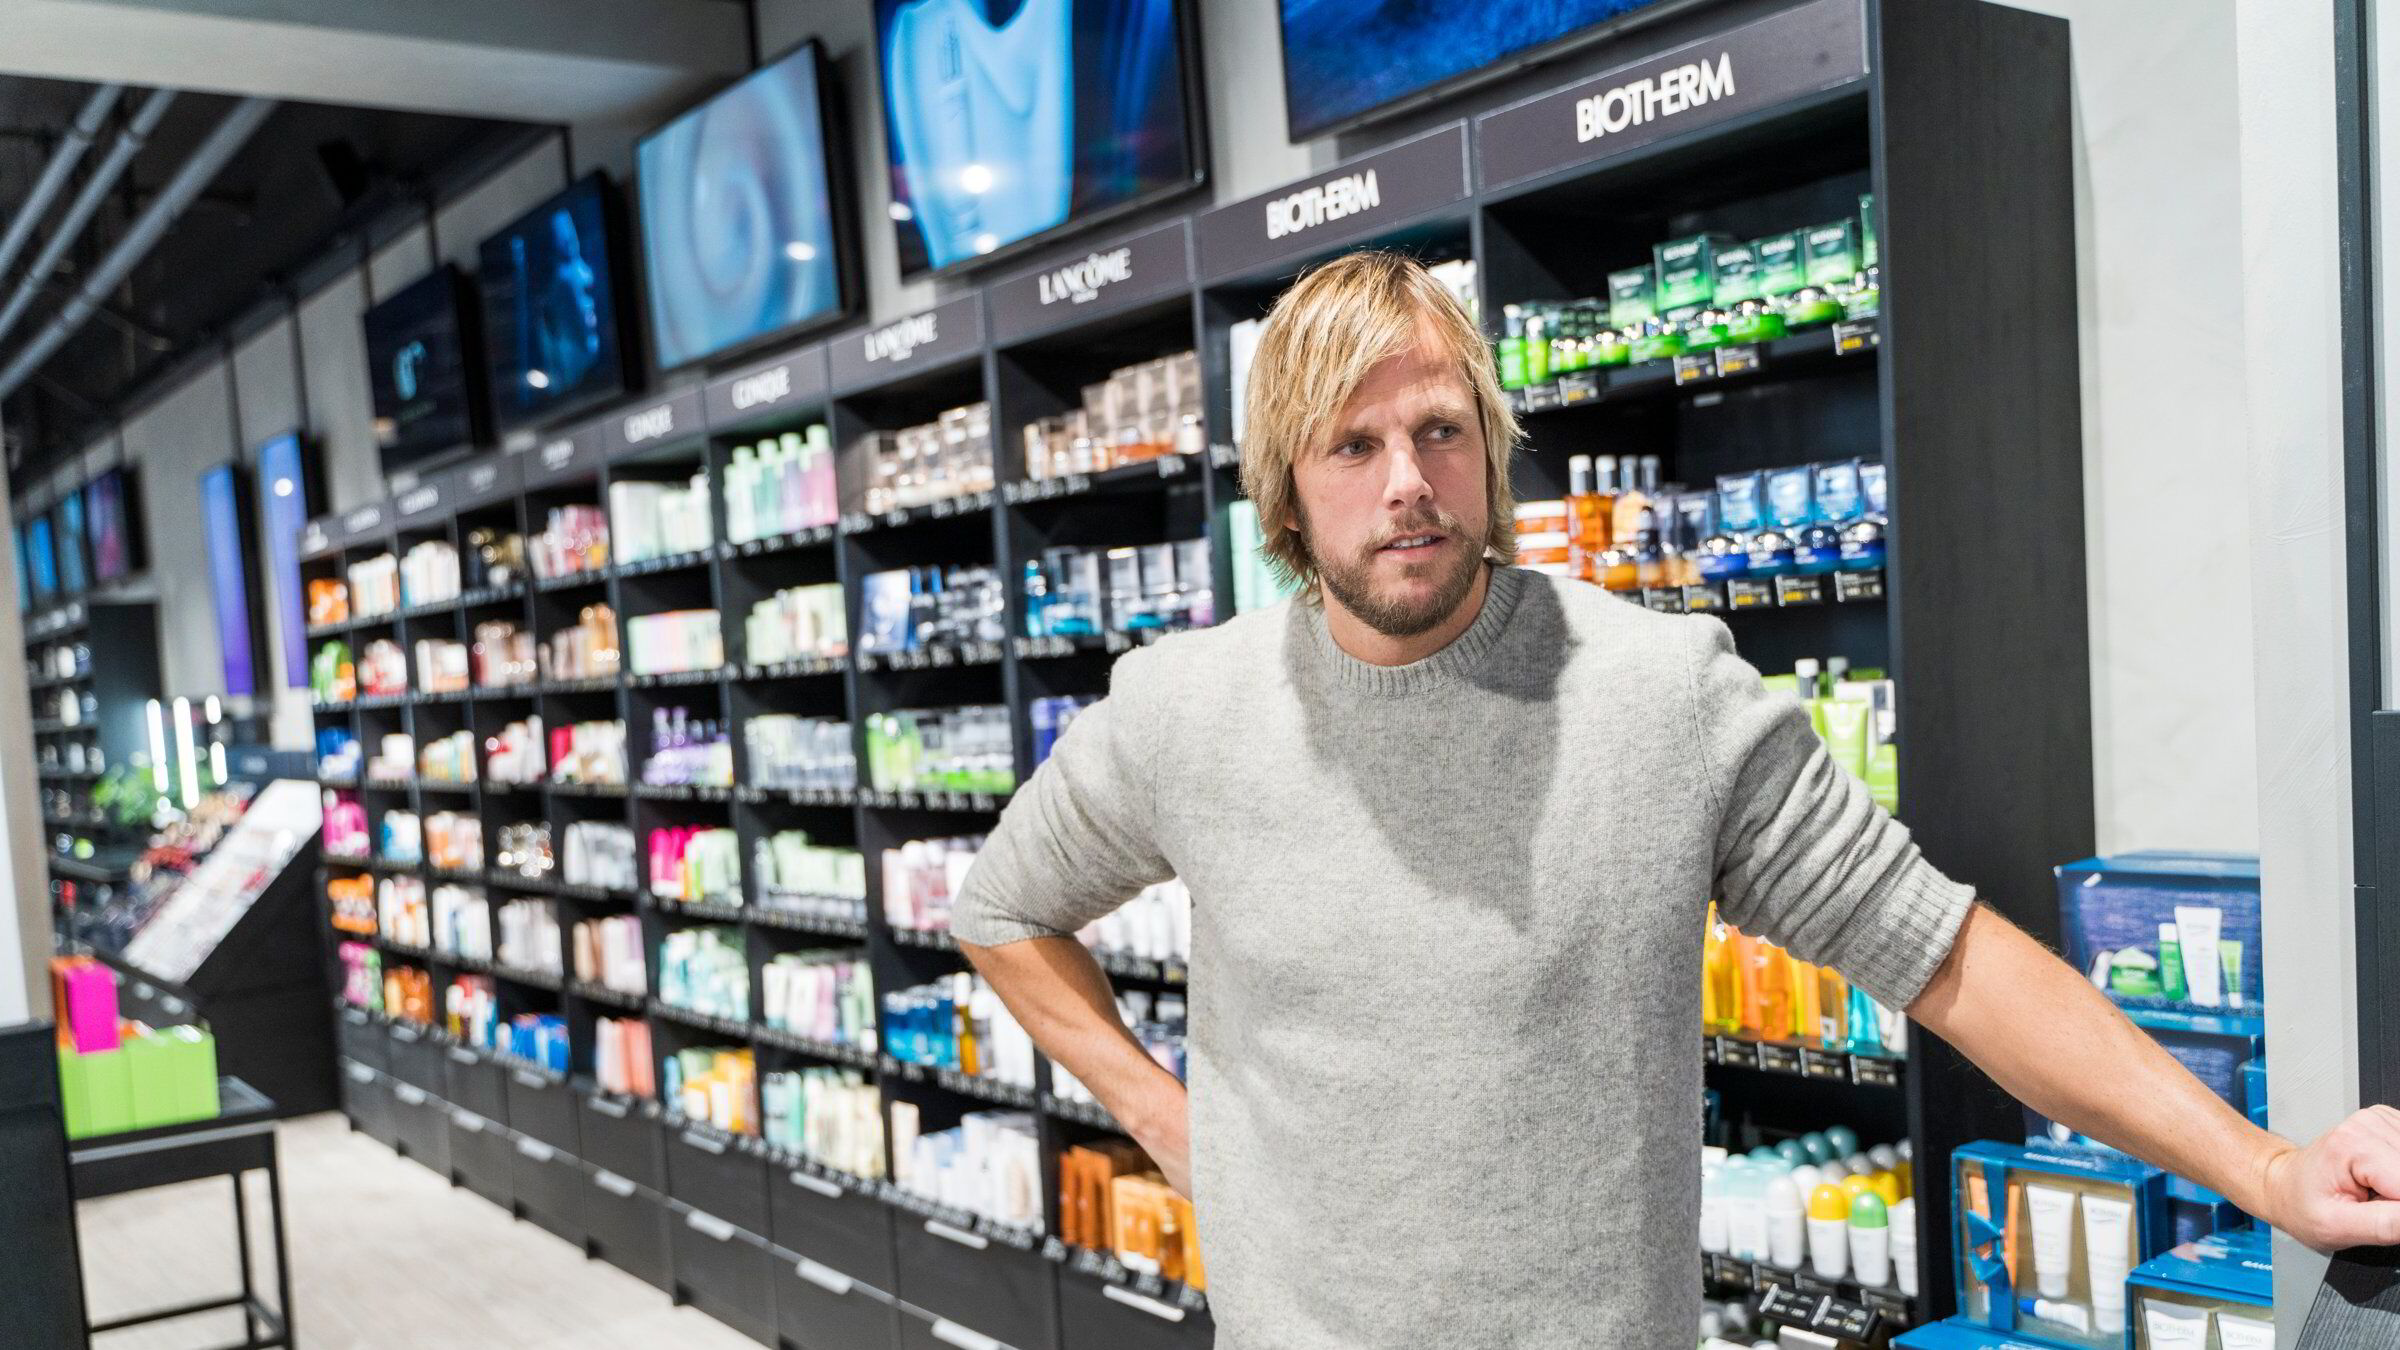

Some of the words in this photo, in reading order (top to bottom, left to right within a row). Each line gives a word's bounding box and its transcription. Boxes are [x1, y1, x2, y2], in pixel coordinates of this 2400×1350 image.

[1576, 52, 1736, 143] BIOTHERM
[1266, 168, 1380, 240] BIOTHERM
[1039, 248, 1132, 305] LANCÔME
